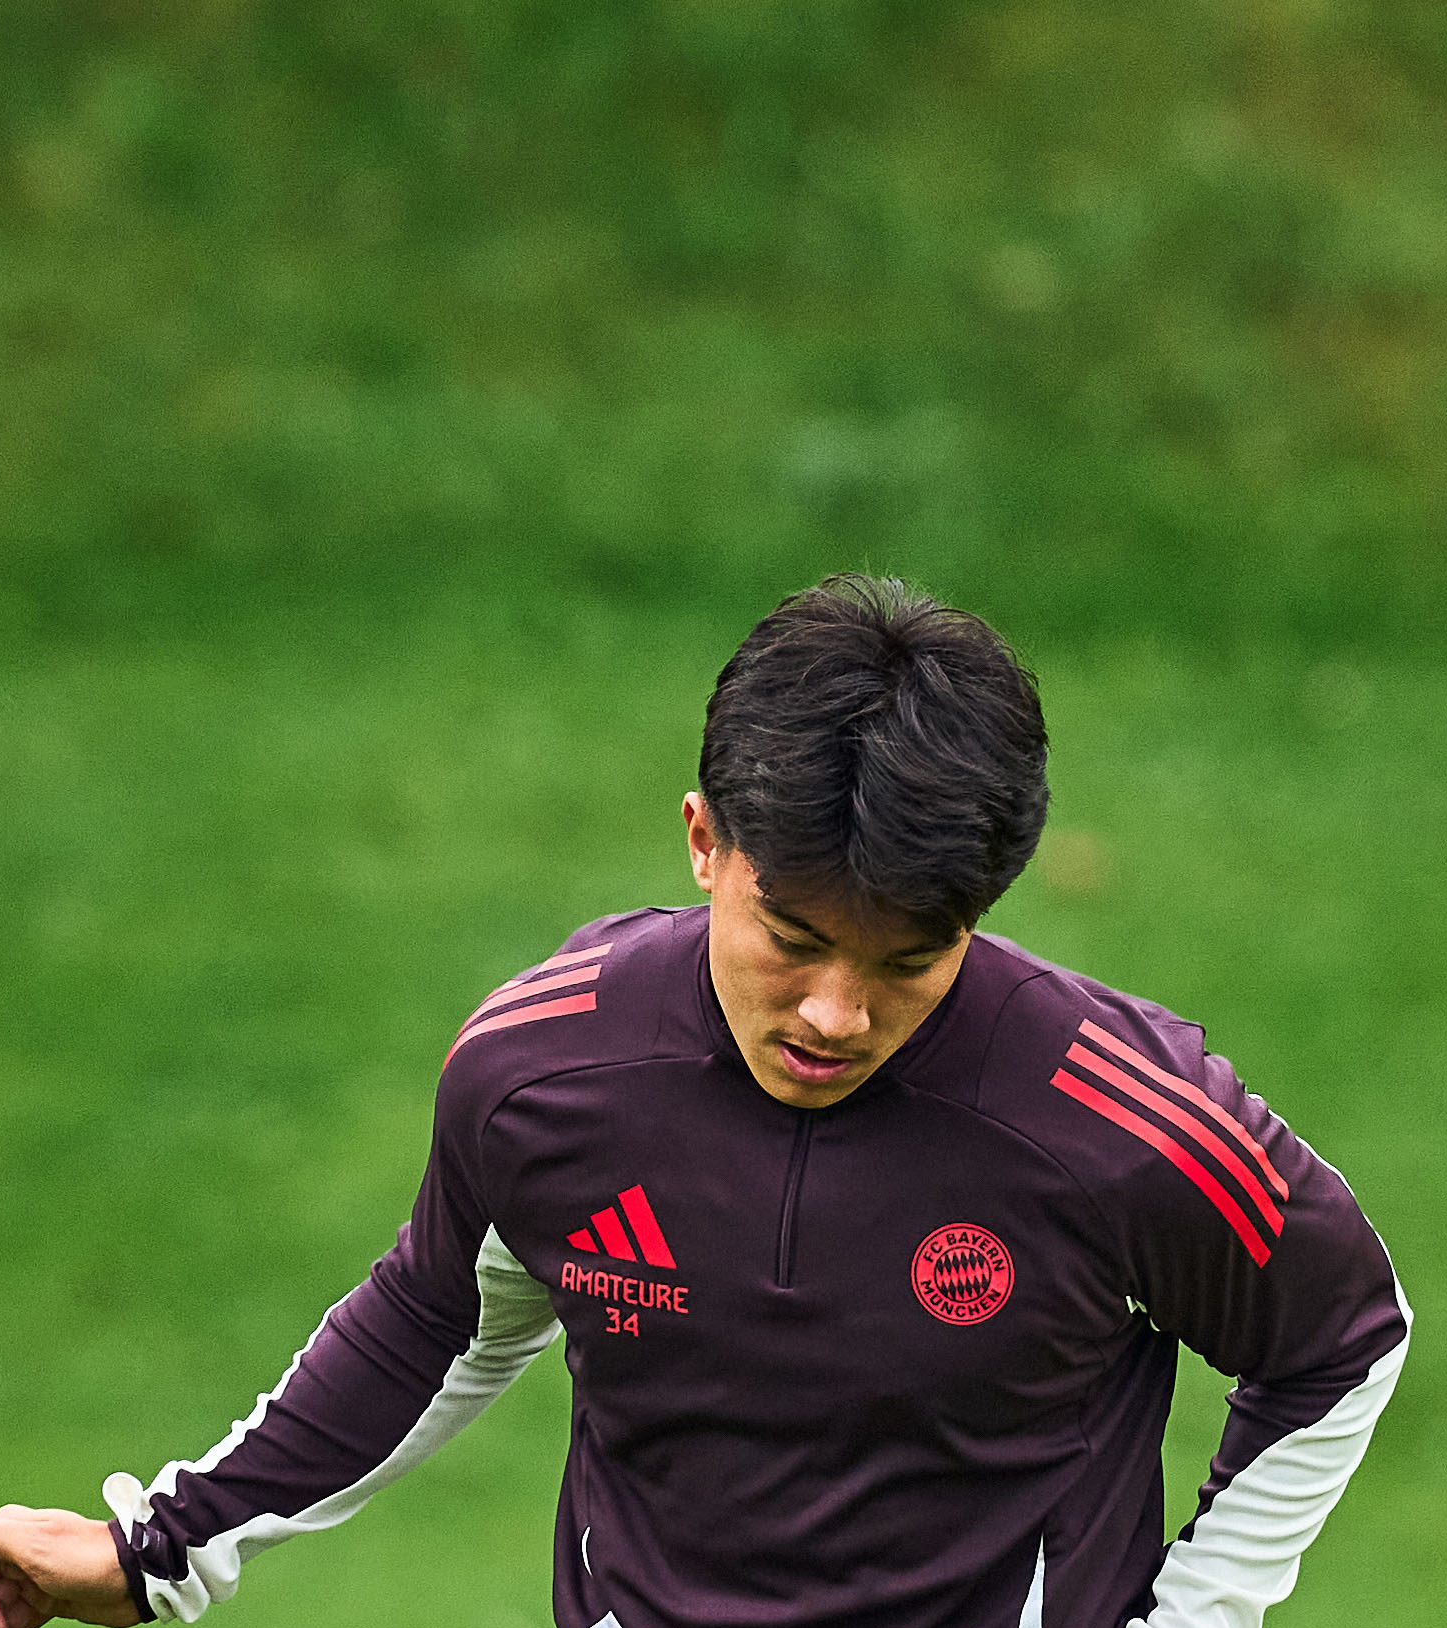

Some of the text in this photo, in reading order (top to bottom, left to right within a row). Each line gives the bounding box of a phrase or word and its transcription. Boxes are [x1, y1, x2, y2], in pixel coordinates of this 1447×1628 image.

[923, 1231, 1005, 1272] FC BAYERN
[561, 1261, 689, 1314] AMATEURE
[605, 1306, 639, 1337] 34
